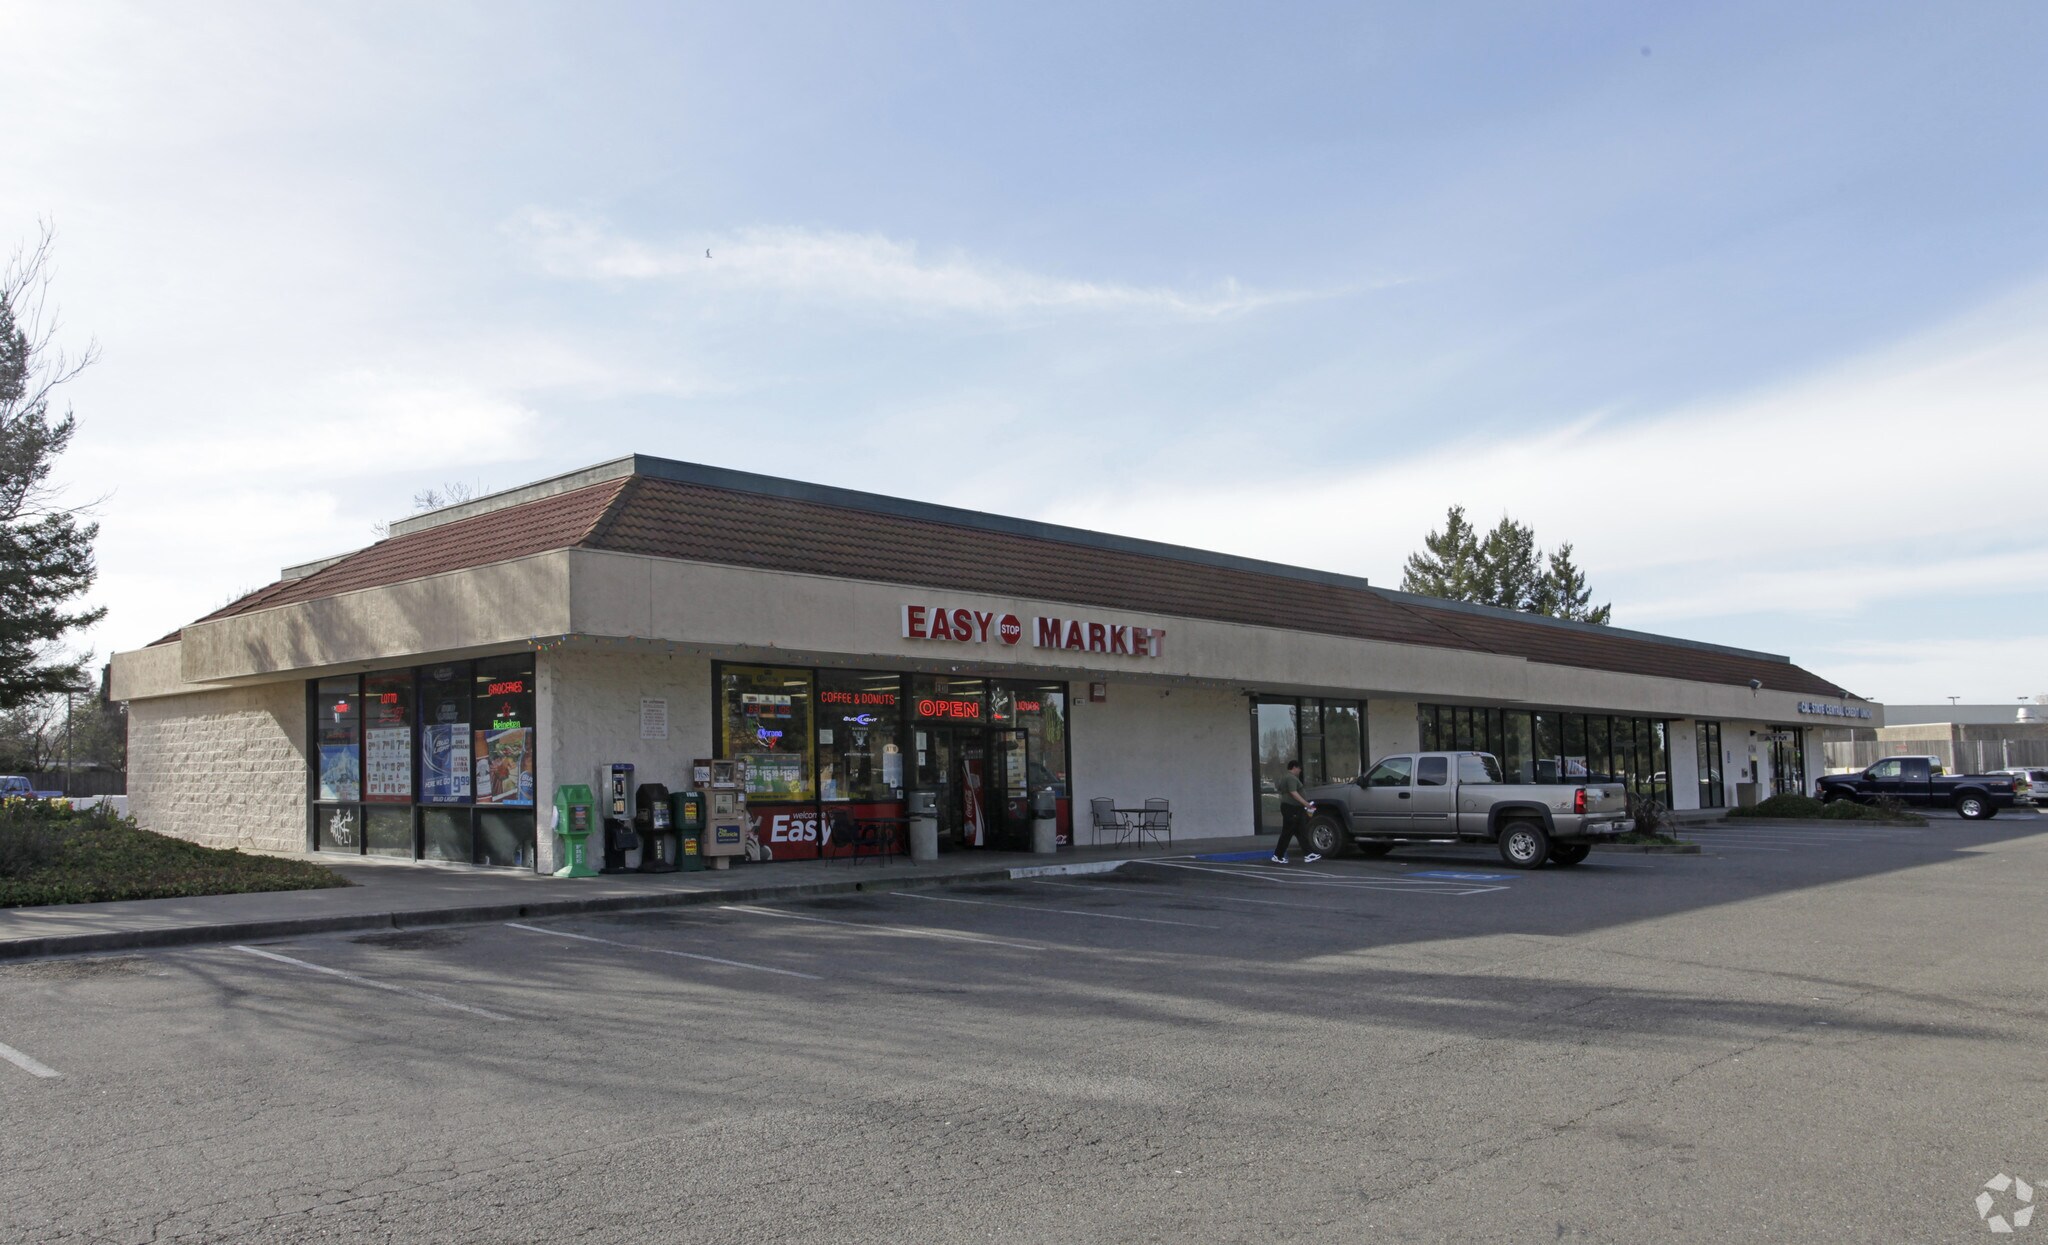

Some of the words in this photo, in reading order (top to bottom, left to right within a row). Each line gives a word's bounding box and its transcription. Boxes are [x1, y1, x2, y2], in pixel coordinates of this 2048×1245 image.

[902, 604, 993, 643] EASY
[1001, 623, 1020, 636] STOP
[1032, 616, 1166, 657] MARKET
[488, 680, 523, 696] GROCERIES
[380, 693, 398, 704] LOTTO
[820, 691, 852, 704] COFFEE
[853, 693, 860, 705] &
[861, 693, 895, 705] DONUTS
[1015, 700, 1040, 711] LIQUOR
[919, 699, 979, 718] OPEN
[1811, 703, 1825, 715] STATE
[1825, 704, 1845, 717] CENTRAL
[1845, 706, 1860, 718] CREDIT
[1860, 707, 1873, 719] UNION
[492, 719, 521, 731] Heineken
[756, 728, 783, 739] Corona
[770, 814, 834, 847] Easy
